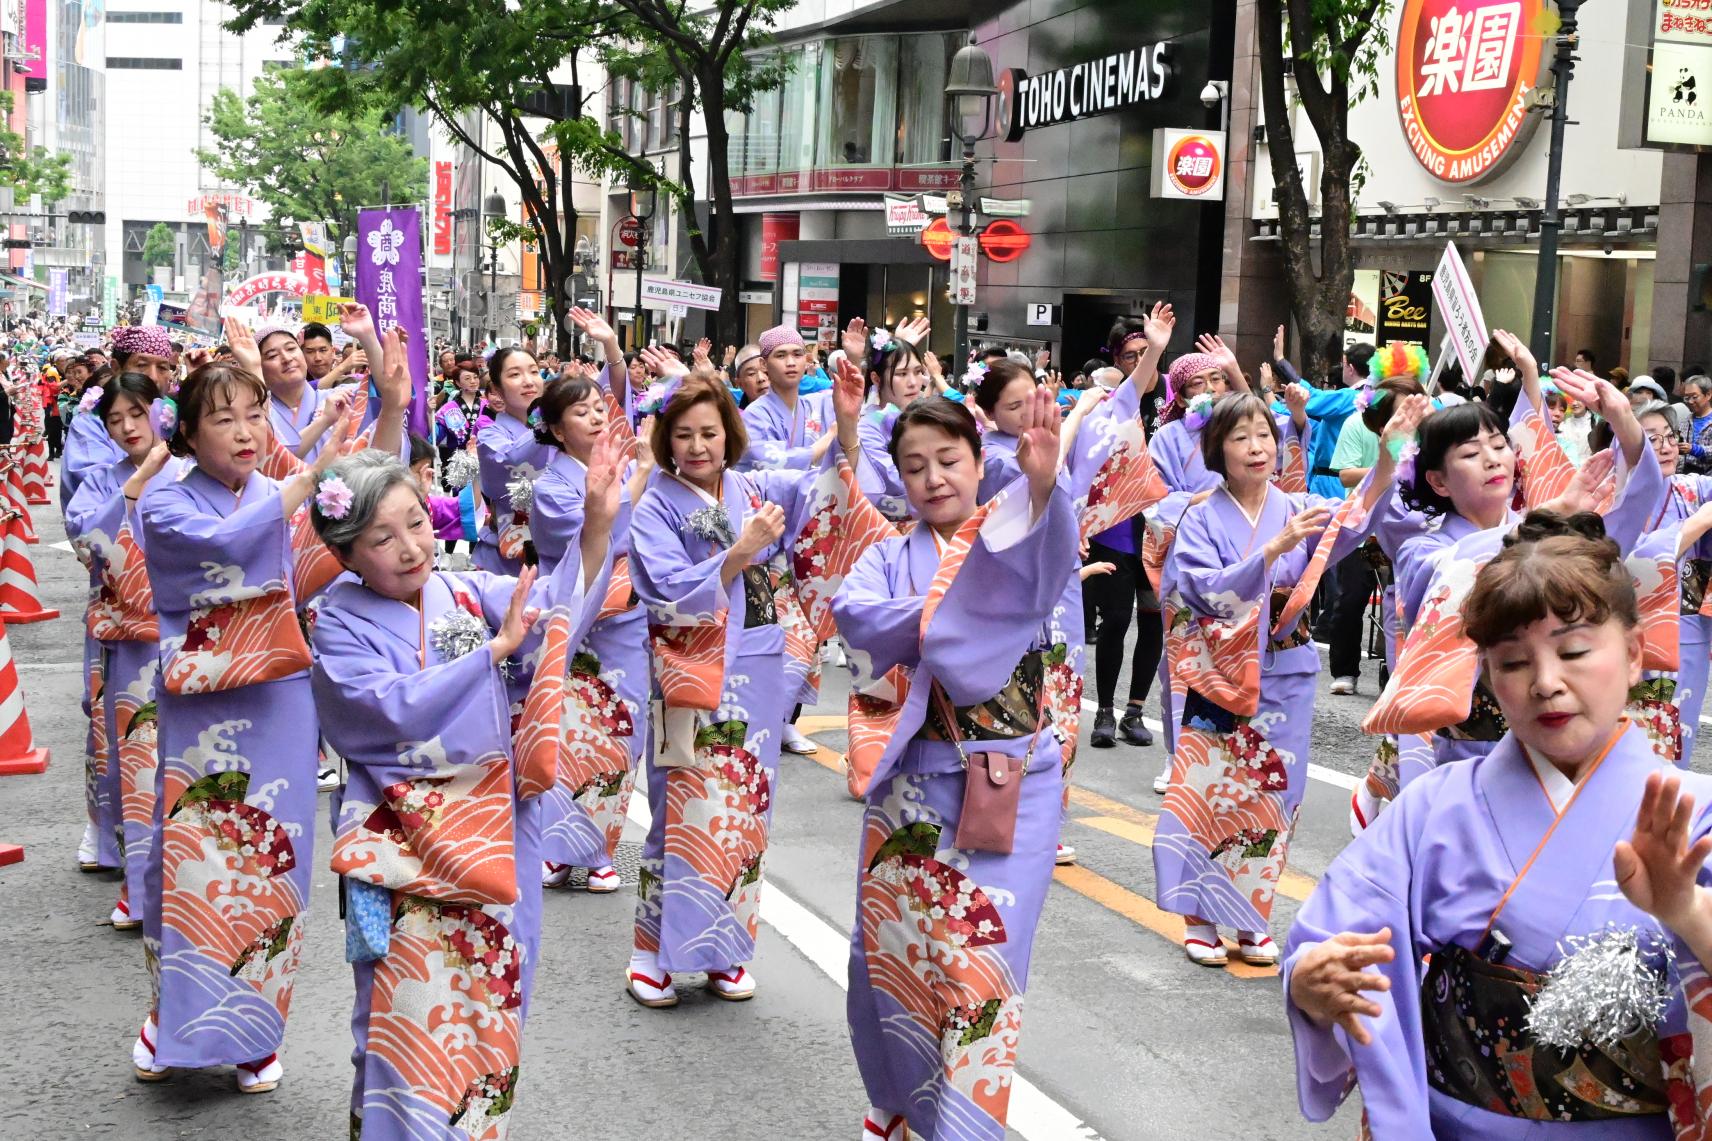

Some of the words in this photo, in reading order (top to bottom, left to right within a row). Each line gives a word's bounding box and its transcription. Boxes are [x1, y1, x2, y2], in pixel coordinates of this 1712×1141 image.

[1417, 2, 1521, 97] 楽園
[1019, 69, 1066, 127] TOHO
[1070, 42, 1166, 116] CINEMAS
[1660, 107, 1705, 120] PANDA
[1400, 95, 1445, 176] EXCITING
[1448, 80, 1532, 179] AMUSEMENT
[1176, 155, 1214, 177] 楽園
[1419, 274, 1432, 283] 8F
[646, 285, 716, 303] 鹿児島県ユニセフ協会
[1036, 305, 1047, 320] P
[1384, 295, 1428, 321] Bee
